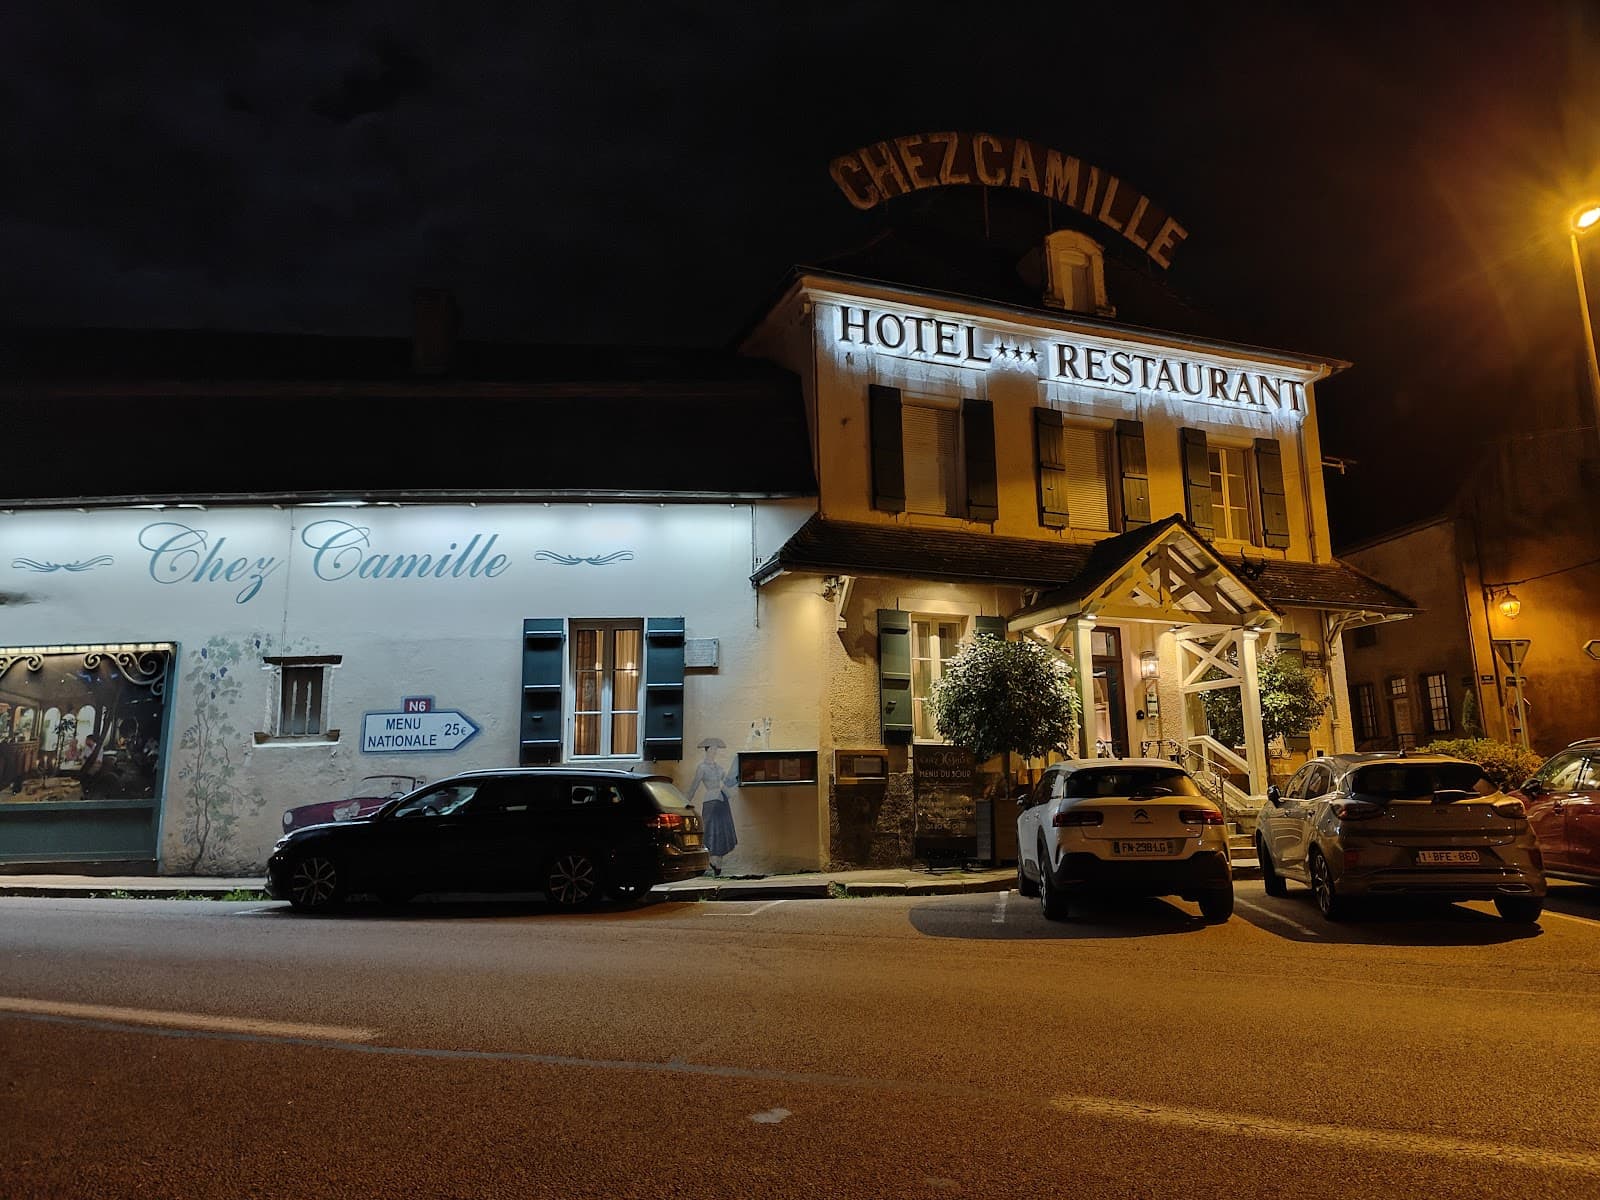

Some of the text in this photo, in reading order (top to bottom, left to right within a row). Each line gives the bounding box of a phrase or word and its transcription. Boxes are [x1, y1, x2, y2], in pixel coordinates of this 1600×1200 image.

[829, 131, 1189, 270] CHEZ CAMILLE
[839, 305, 1305, 412] HOTEL RESTAURANT
[138, 519, 512, 604] Chez Camille
[385, 718, 422, 731] MENU
[409, 700, 426, 712] N6
[368, 734, 438, 748] NATIONALE
